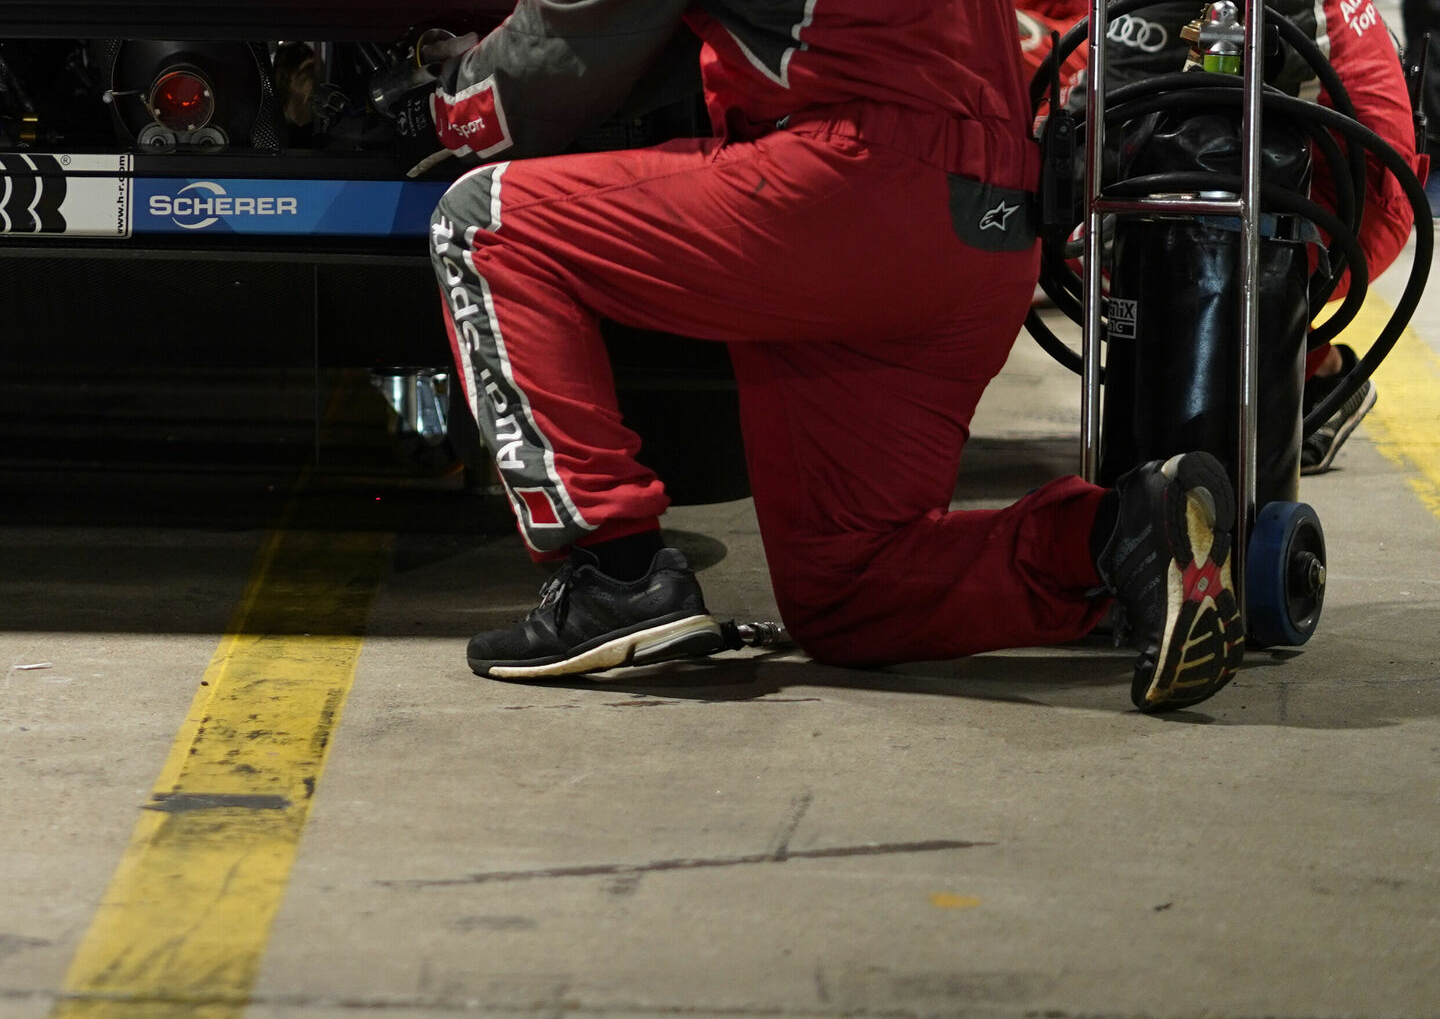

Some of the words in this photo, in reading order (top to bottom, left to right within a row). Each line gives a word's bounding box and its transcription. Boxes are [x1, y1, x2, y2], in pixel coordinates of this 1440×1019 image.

[1350, 2, 1377, 36] Top
[452, 116, 485, 139] Sport
[149, 195, 298, 216] SCHERER
[431, 215, 480, 354] Sport
[481, 368, 525, 469] Audi
